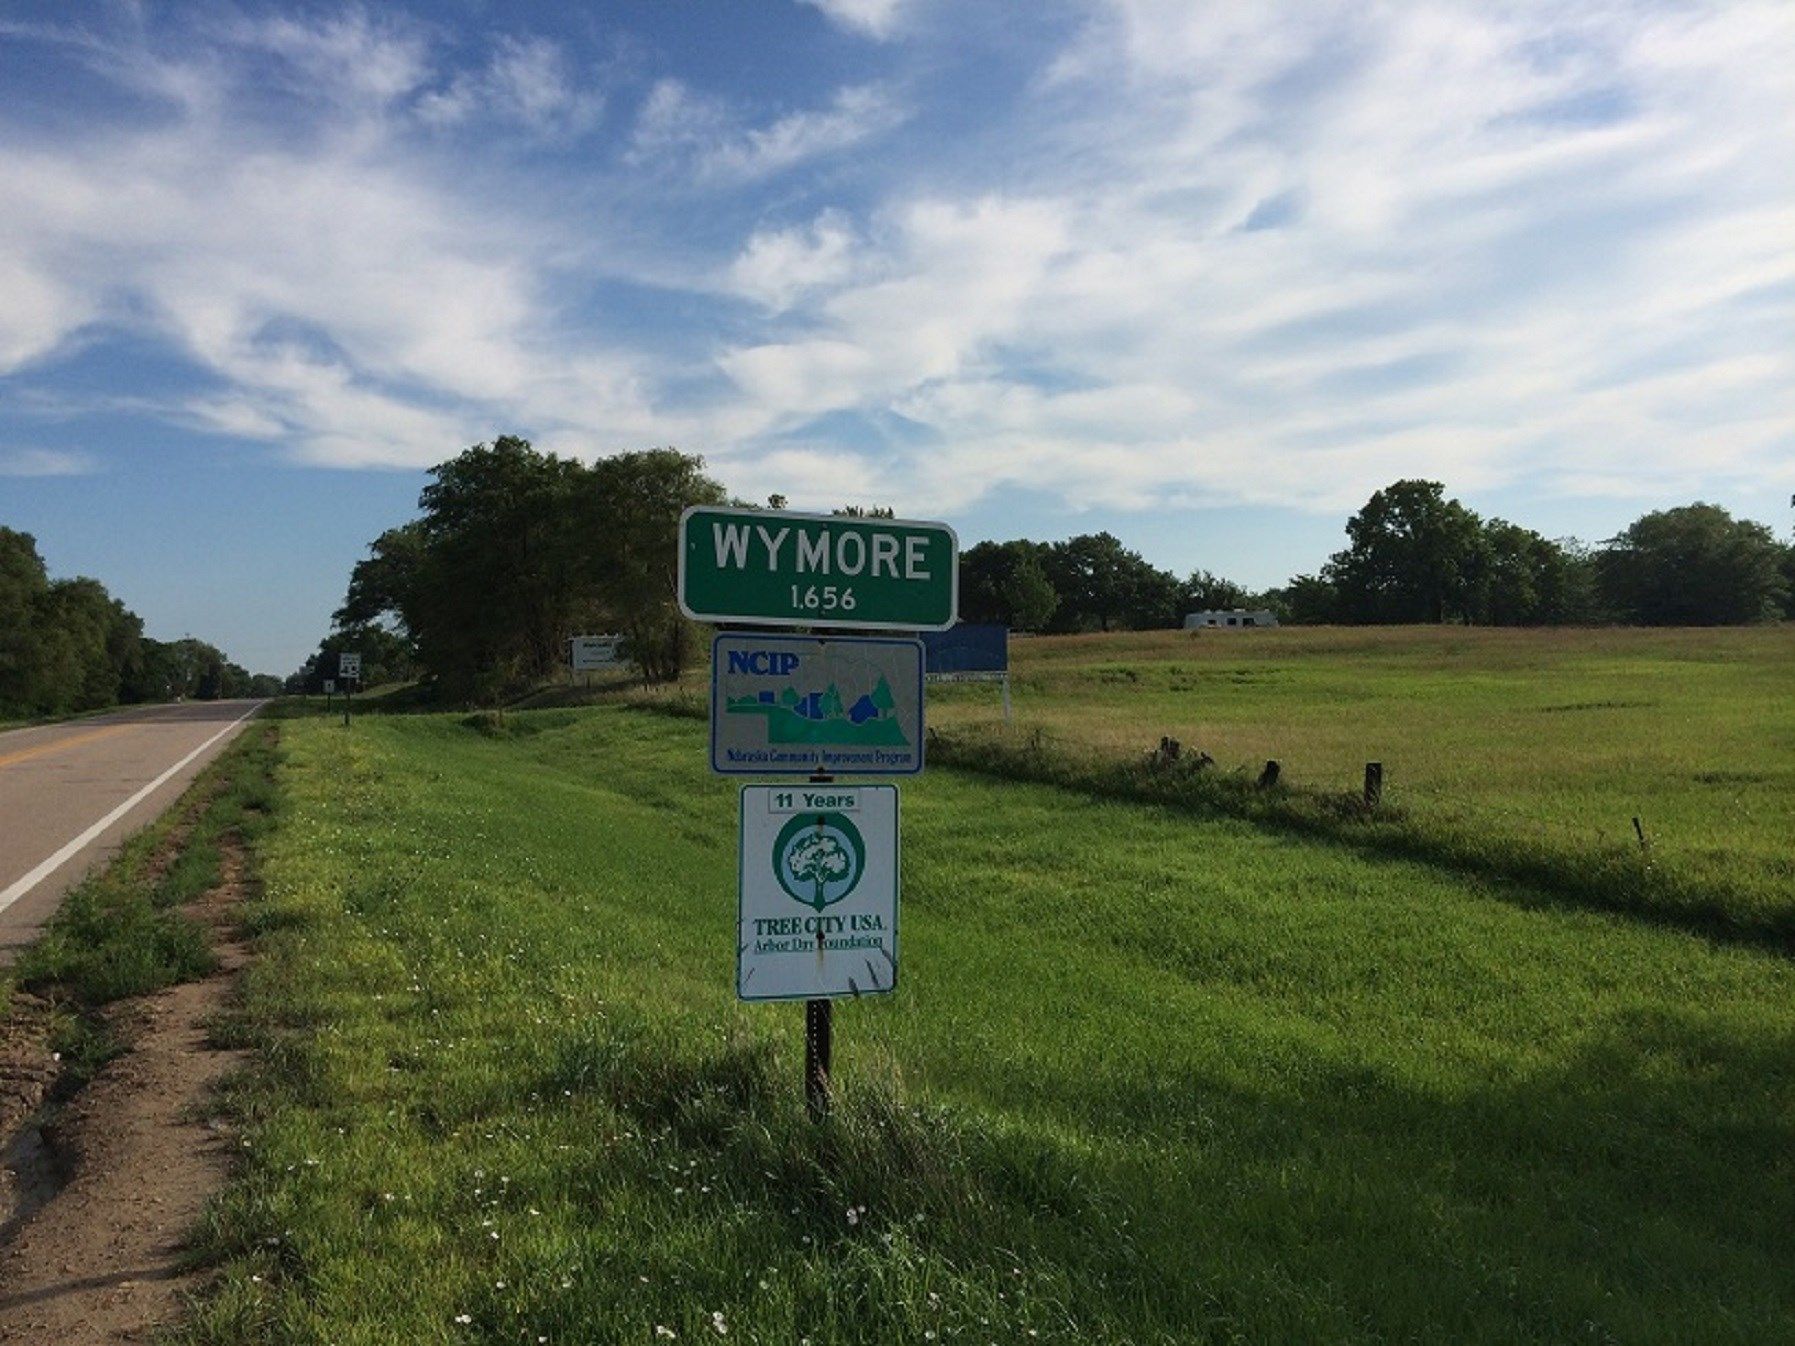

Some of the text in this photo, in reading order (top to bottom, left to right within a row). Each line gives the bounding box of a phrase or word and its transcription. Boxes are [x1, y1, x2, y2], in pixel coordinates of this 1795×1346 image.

[712, 522, 931, 579] WYMORE
[727, 650, 800, 675] NCIP
[775, 793, 855, 808] 11 Years
[753, 917, 802, 936] TREE
[804, 916, 846, 933] CITY
